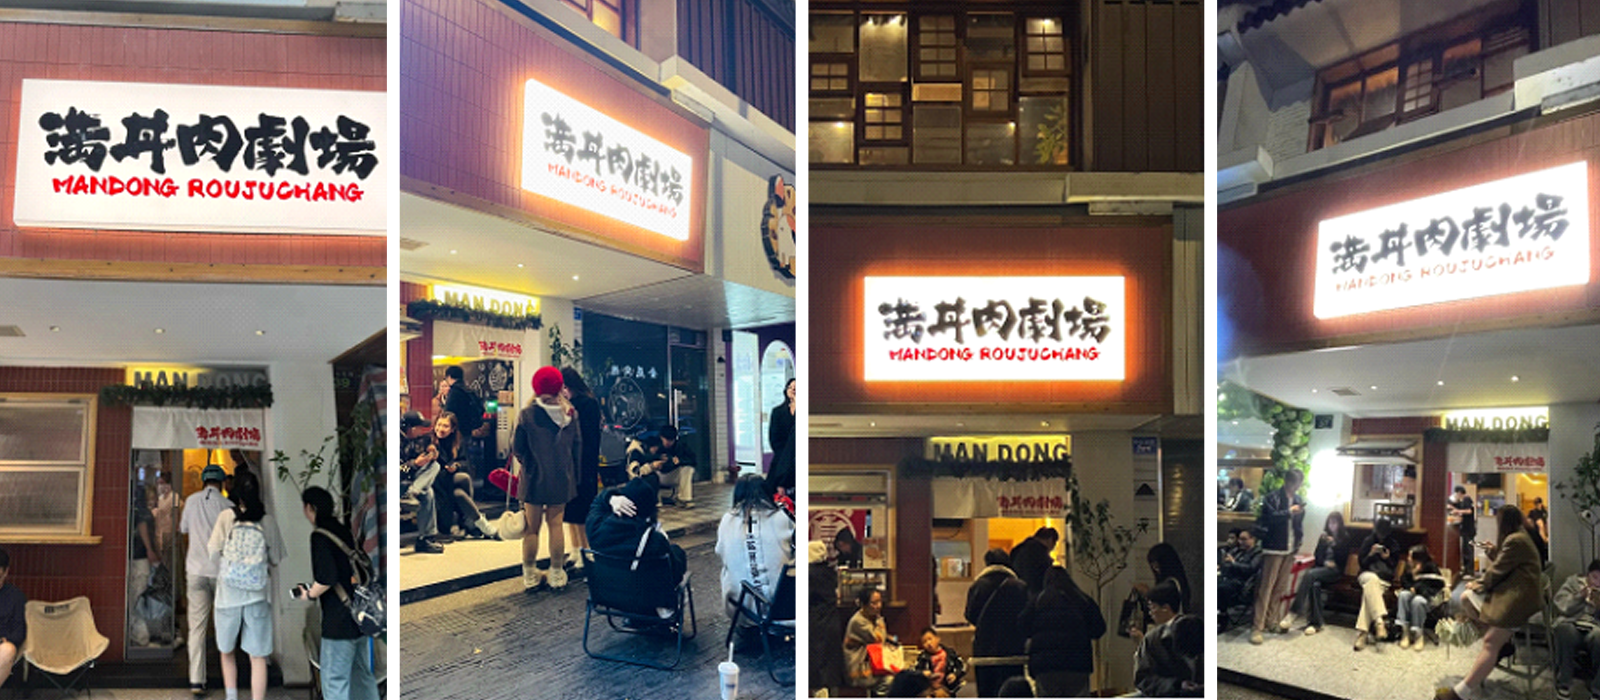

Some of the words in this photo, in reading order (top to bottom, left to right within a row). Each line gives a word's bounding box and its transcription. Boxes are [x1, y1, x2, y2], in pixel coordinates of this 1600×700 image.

[52, 175, 180, 198] MANDONG
[187, 178, 364, 202] ROUJUCHANG
[889, 347, 973, 361] MANDONG
[979, 346, 1100, 361] ROUJUCHANG
[134, 370, 188, 389] MAN
[1446, 416, 1485, 431] MAN
[1492, 415, 1547, 431] DONG
[933, 442, 988, 461] MAN
[998, 442, 1069, 462] DONG
